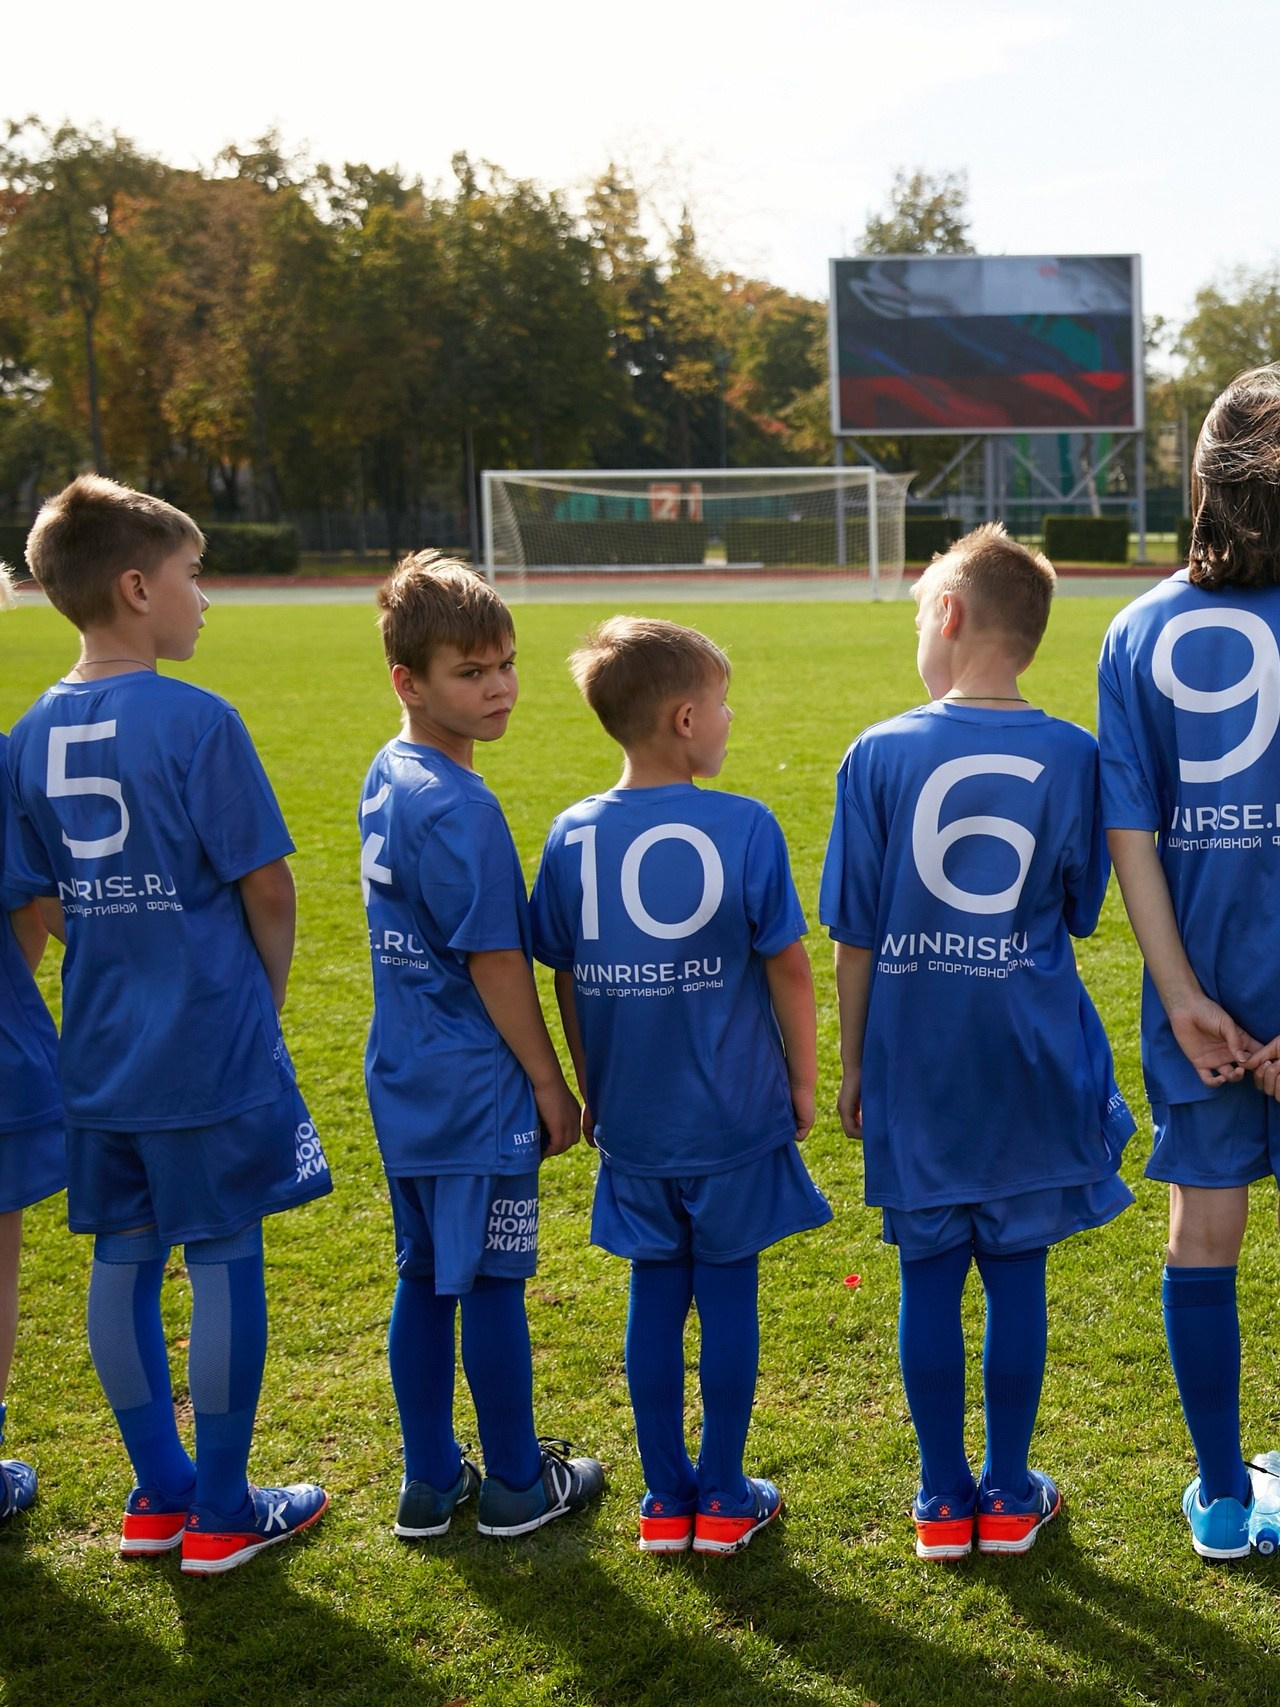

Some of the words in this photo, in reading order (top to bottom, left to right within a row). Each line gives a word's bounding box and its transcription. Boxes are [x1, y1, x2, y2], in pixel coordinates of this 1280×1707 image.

[1152, 608, 1280, 783] 9
[46, 719, 130, 859] 5
[912, 753, 1045, 915] 6
[564, 823, 724, 940] 10
[381, 955, 429, 970] ФОРМЫ
[573, 957, 722, 983] WINRISE.RU
[606, 985, 675, 998] СПОРТИВНОЙ
[683, 979, 723, 993] ФОРМЫ
